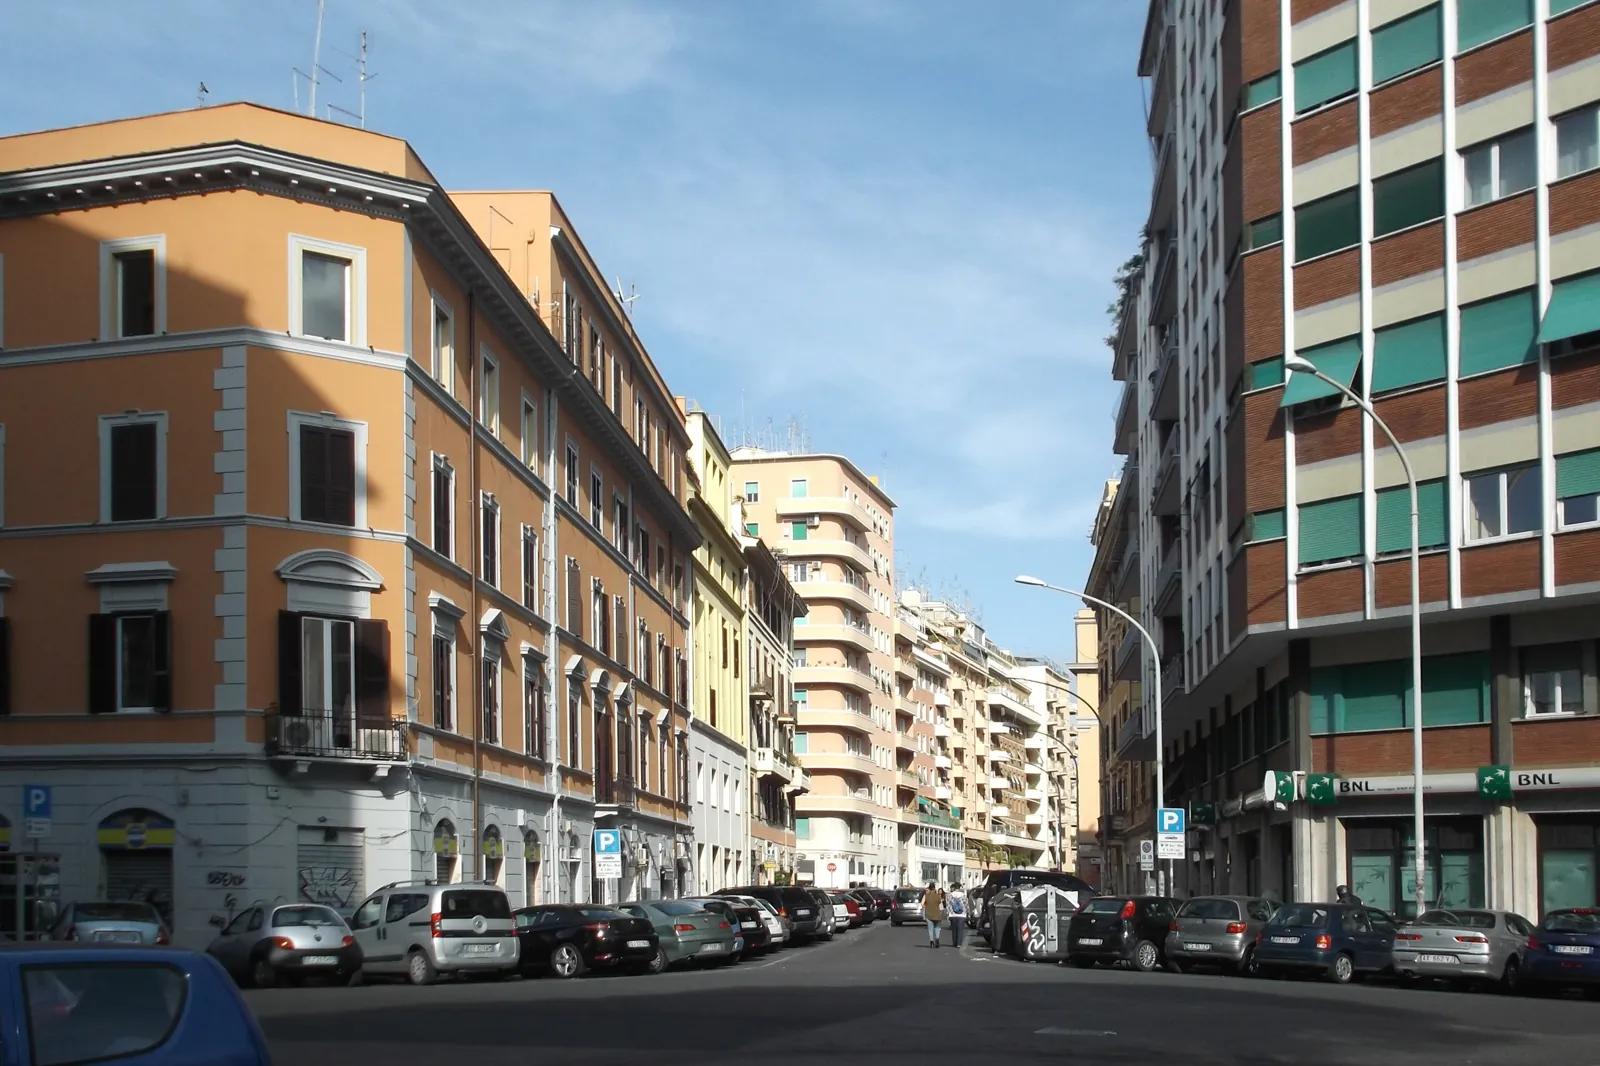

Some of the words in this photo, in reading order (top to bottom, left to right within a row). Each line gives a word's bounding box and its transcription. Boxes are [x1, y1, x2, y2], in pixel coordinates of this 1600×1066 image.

[1340, 781, 1374, 793] BNL
[1517, 773, 1560, 786] BNL
[31, 789, 46, 812] P
[1163, 811, 1179, 830] P
[600, 832, 615, 851] P
